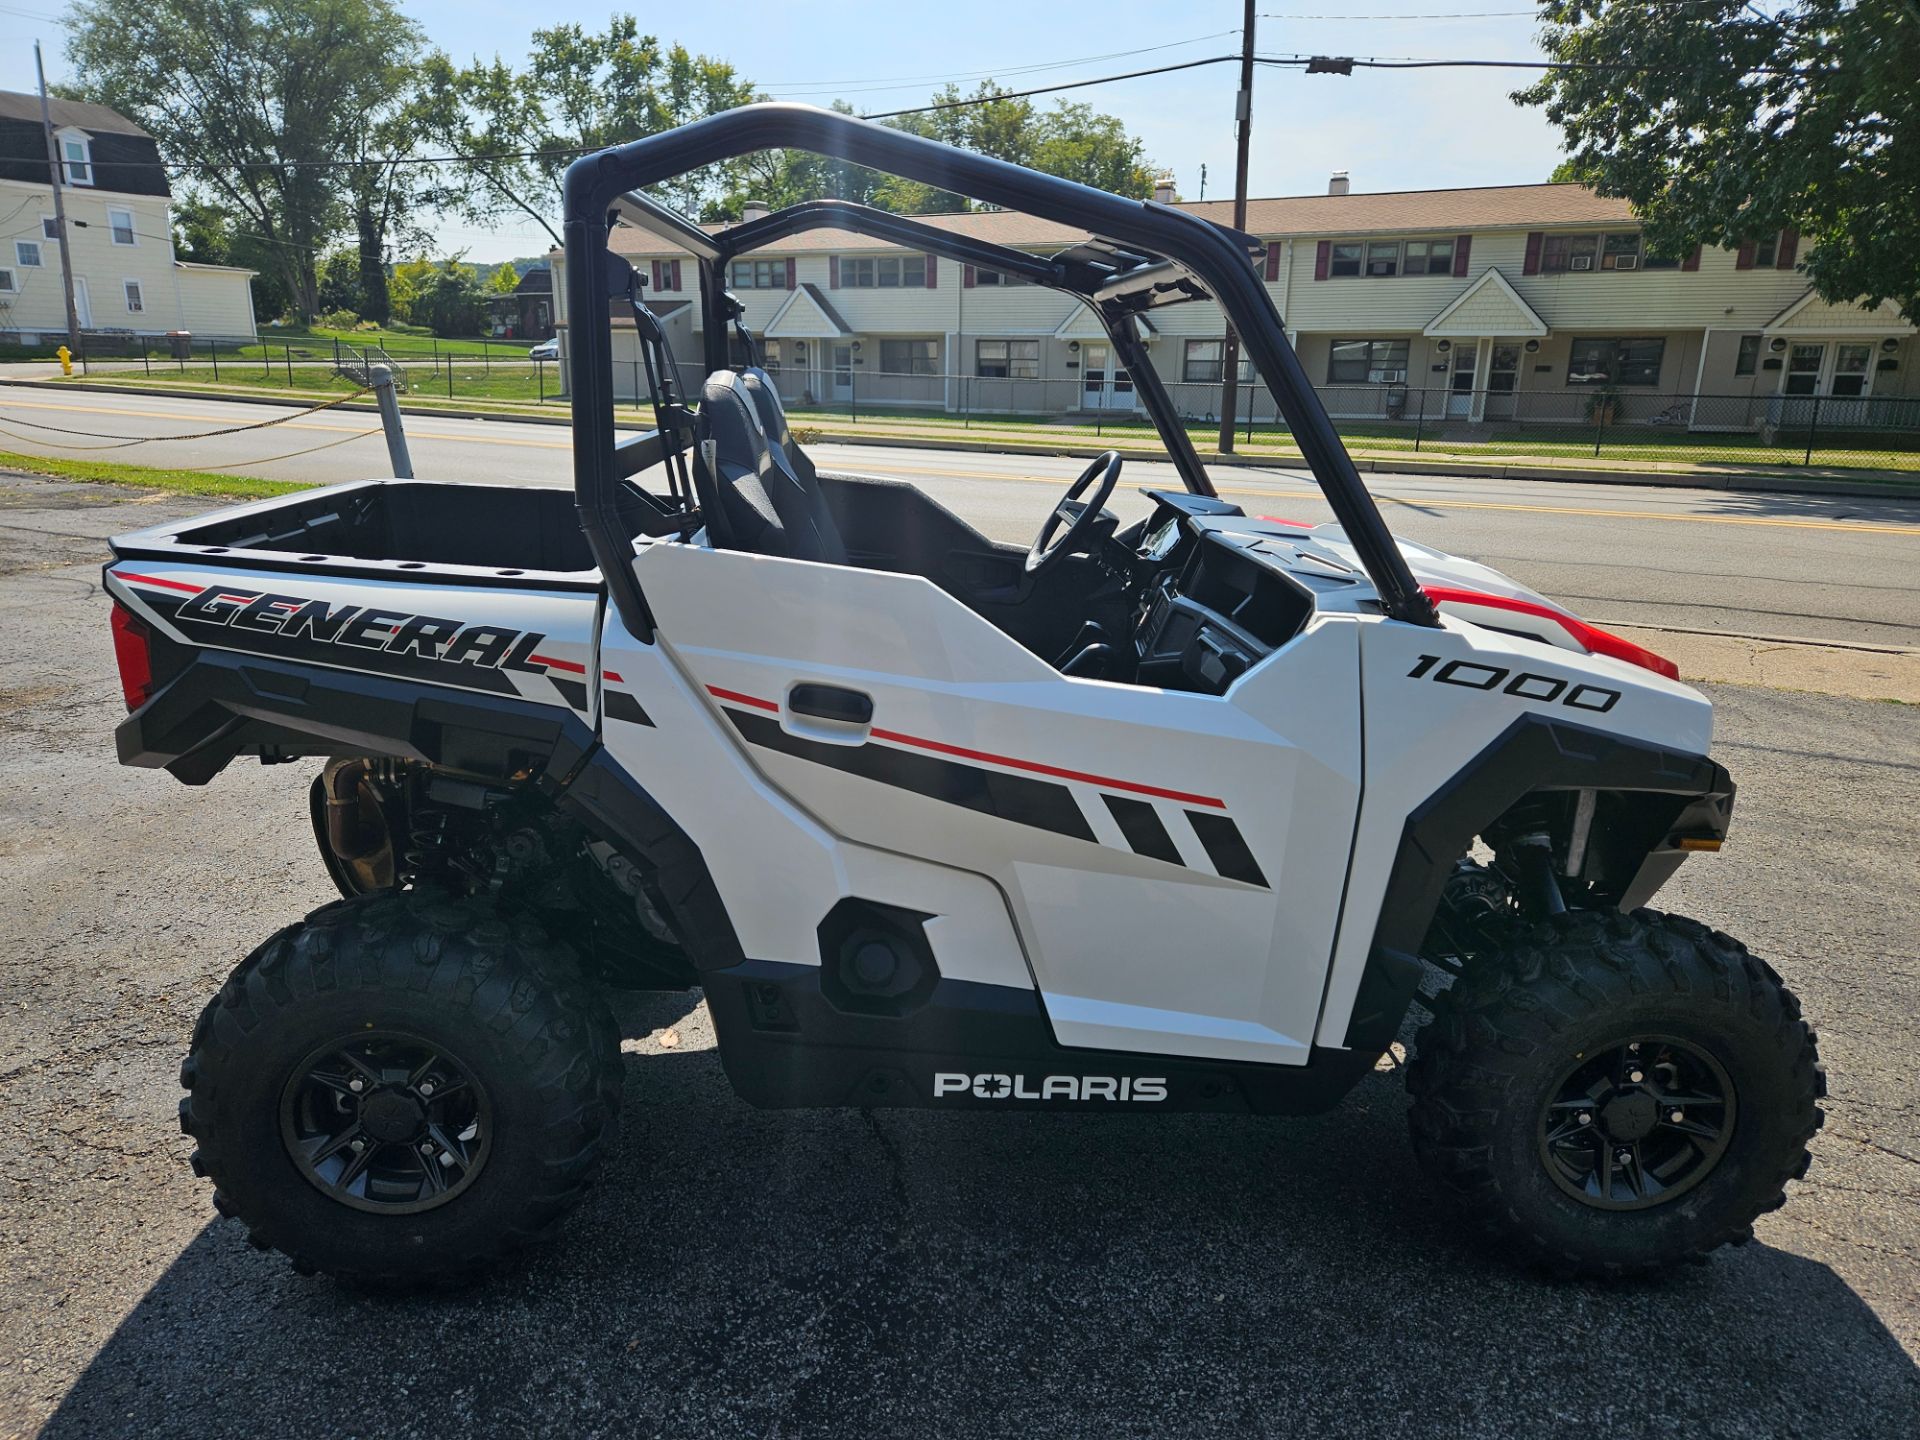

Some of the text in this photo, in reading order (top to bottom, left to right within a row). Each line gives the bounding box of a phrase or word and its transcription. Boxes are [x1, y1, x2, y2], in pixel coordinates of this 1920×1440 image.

[175, 585, 550, 675] GENERAL
[1407, 654, 1621, 713] 1000
[933, 1072, 1168, 1102] POLARIS
